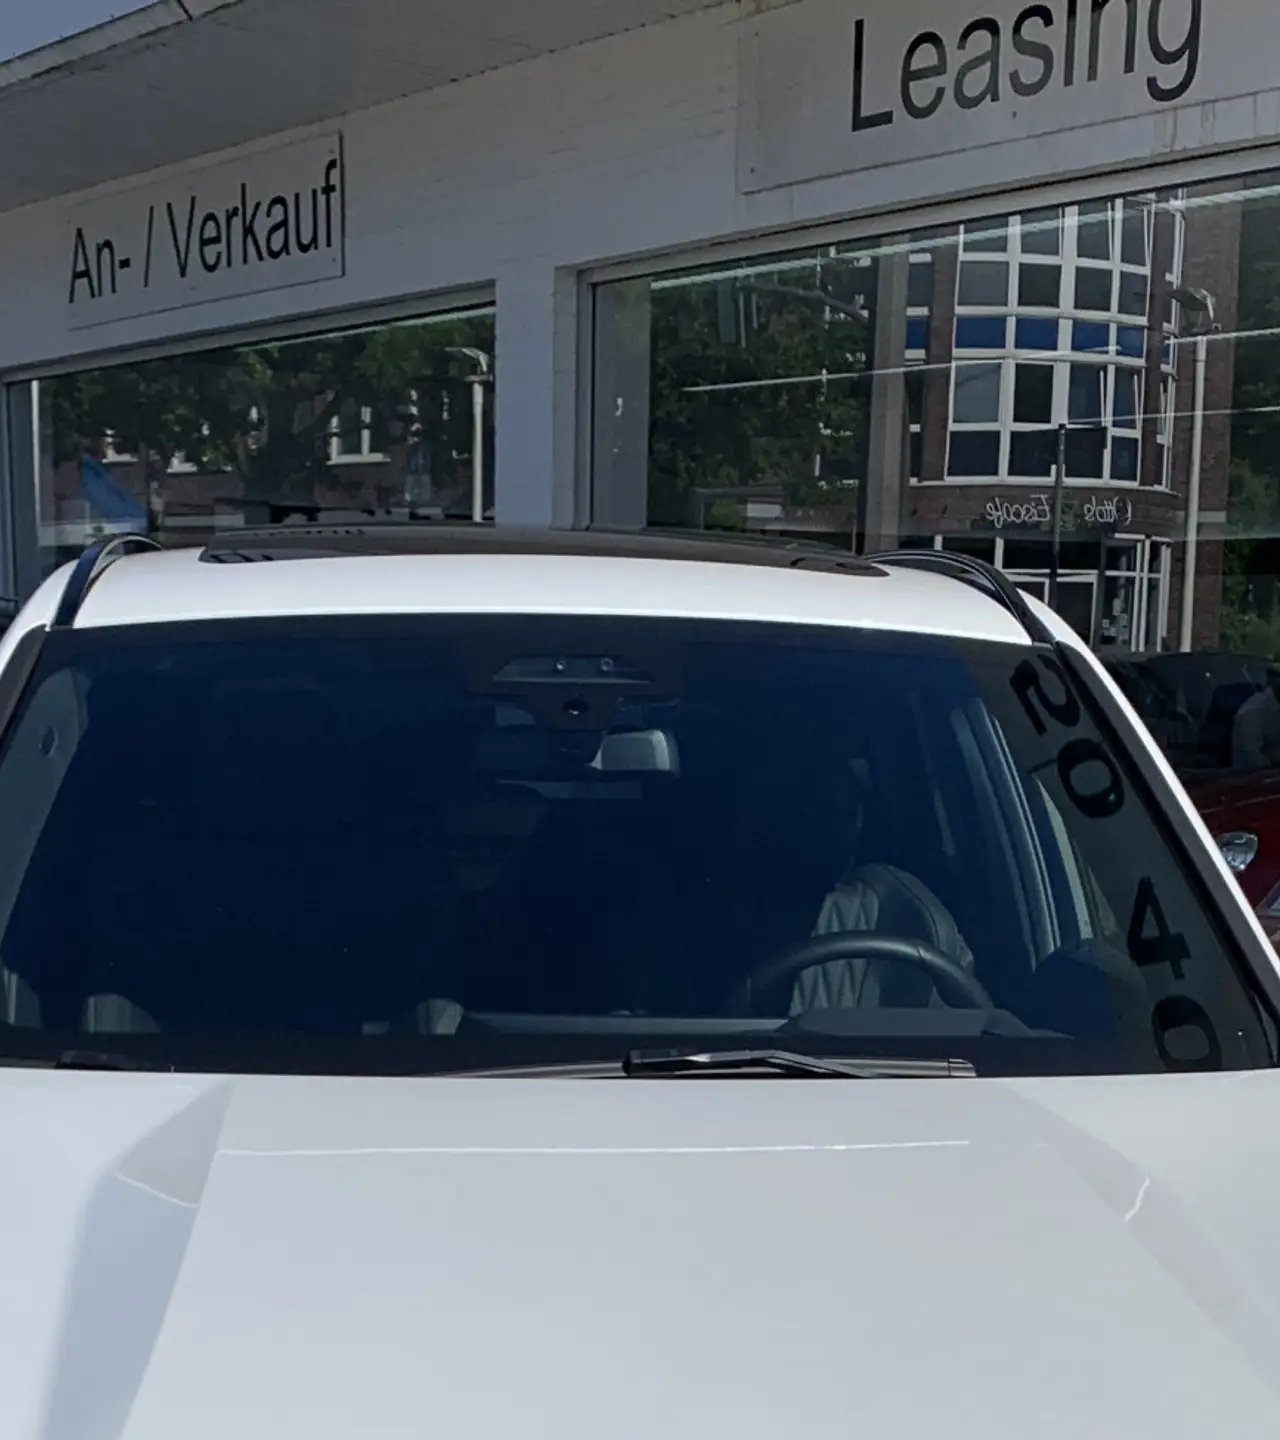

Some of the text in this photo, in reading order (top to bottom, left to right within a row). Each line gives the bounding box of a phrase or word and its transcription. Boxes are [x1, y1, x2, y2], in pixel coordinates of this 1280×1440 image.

[851, 0, 1203, 132] Leasing
[69, 227, 131, 304] An-
[167, 158, 337, 279] Verkauf
